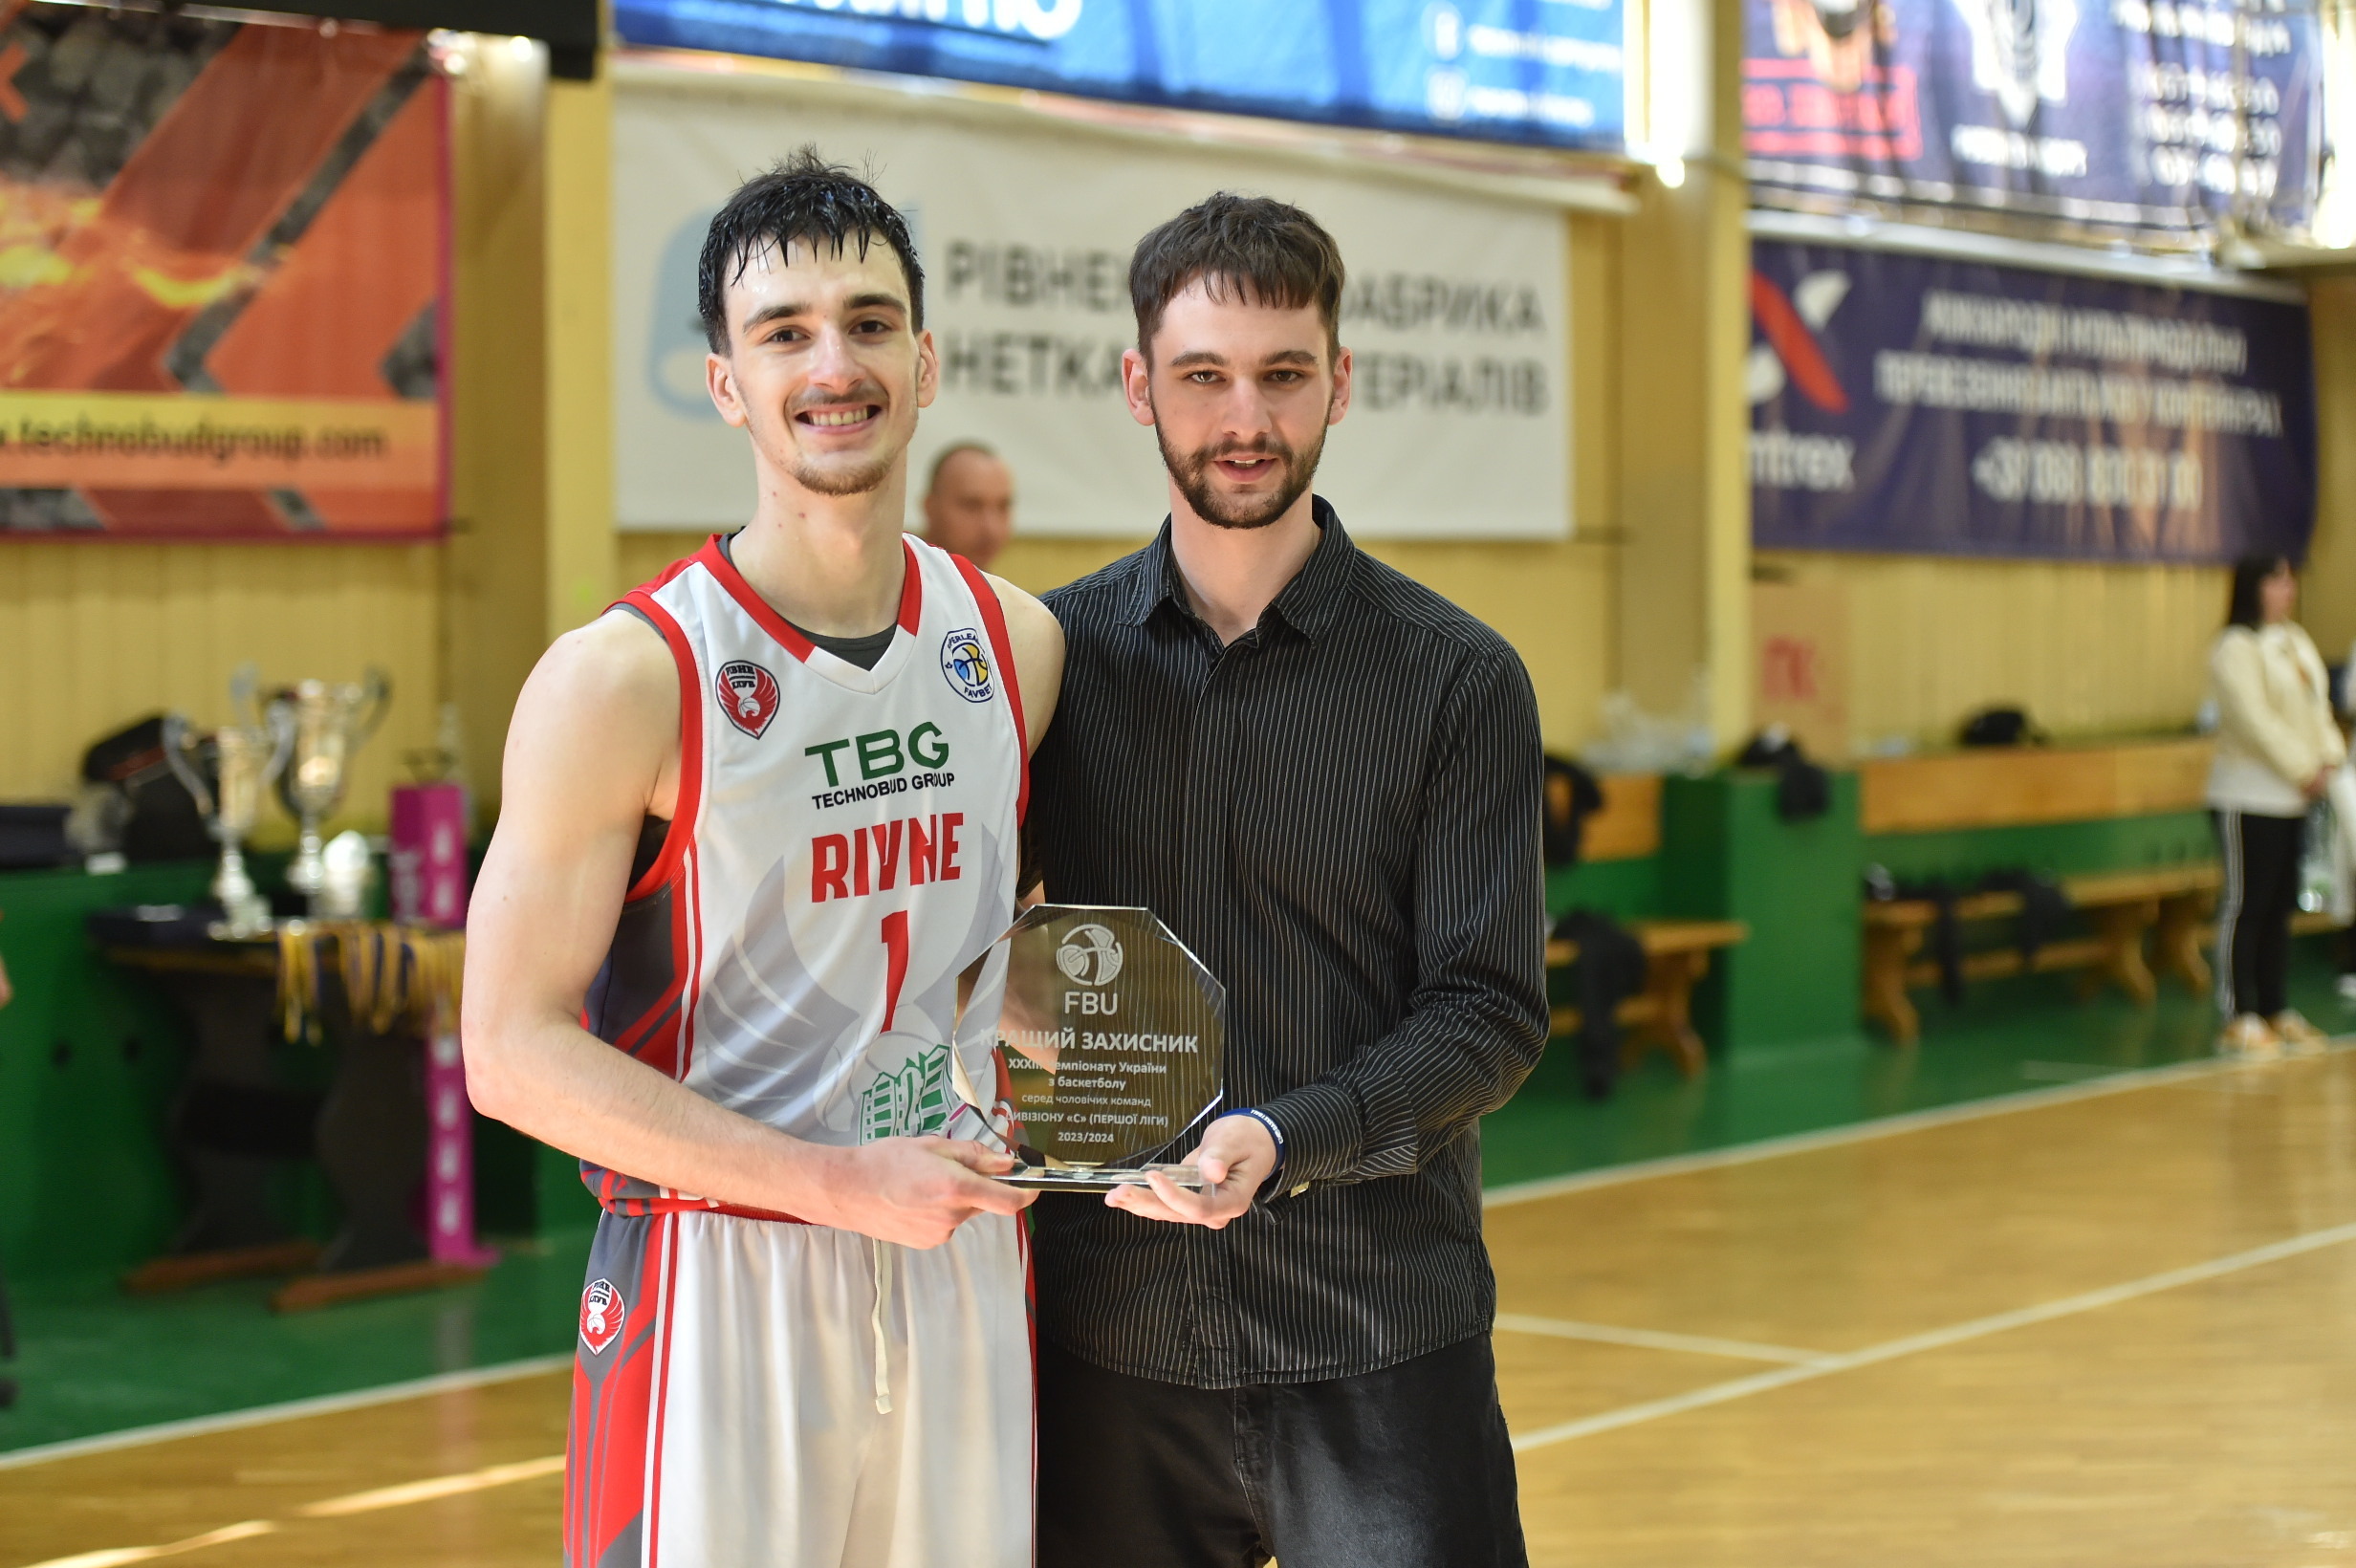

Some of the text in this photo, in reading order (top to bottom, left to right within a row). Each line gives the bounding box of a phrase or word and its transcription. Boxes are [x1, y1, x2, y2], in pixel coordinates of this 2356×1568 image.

[945, 240, 1129, 312] РІВНЕ
[805, 721, 949, 788] TBG
[812, 773, 955, 810] TECHNOBUD GROUP
[811, 813, 964, 904] RIVNE
[881, 909, 909, 1034] 1
[1063, 991, 1118, 1015] FBU
[1081, 1032, 1198, 1053] ЗАХИСНИК
[1049, 1059, 1117, 1075] емпіонату
[1119, 1061, 1167, 1076] України
[1048, 1076, 1126, 1091] з баскетболу
[1021, 1094, 1151, 1108] серед чоловічих команд
[1089, 1113, 1138, 1126] (ПЕРШОЇ
[1139, 1116, 1169, 1128] ЛІГИ)
[1058, 1131, 1115, 1143] 2023/2024
